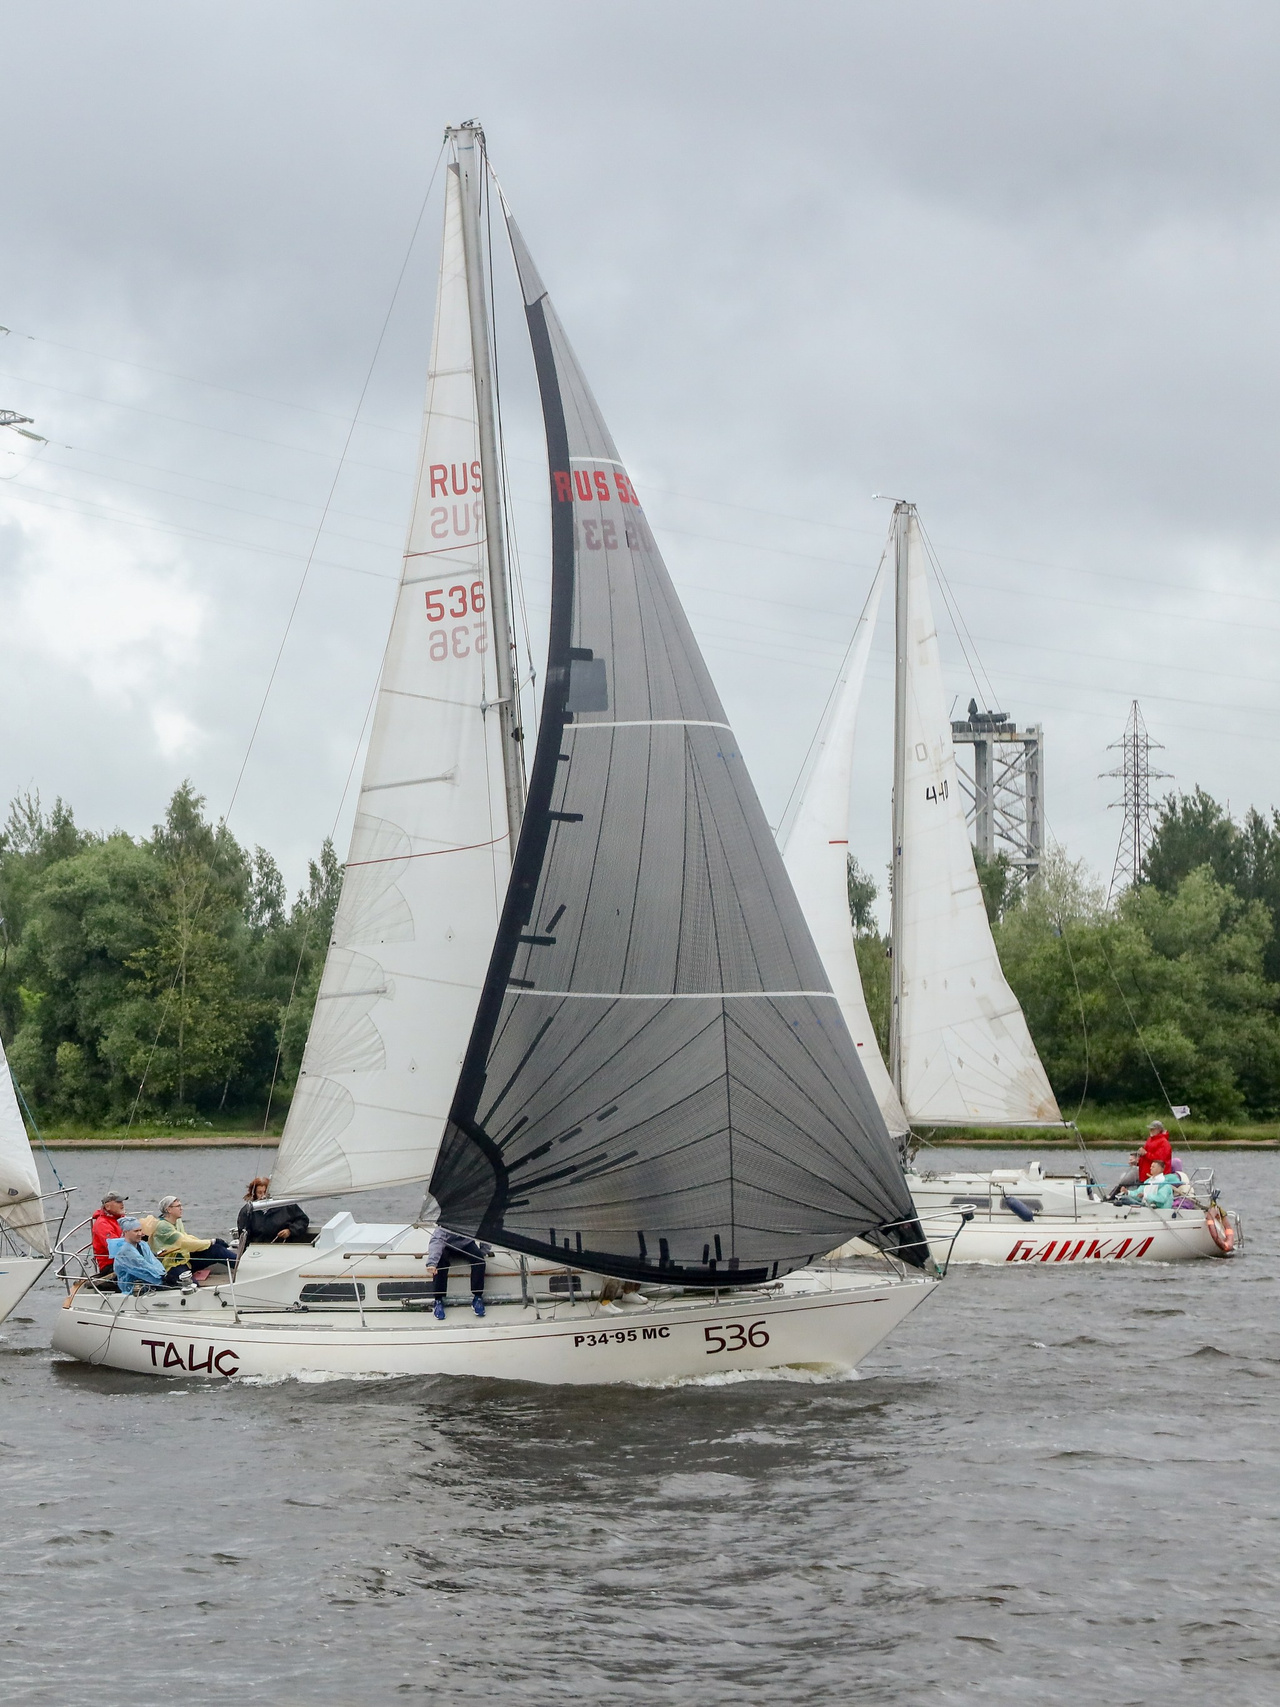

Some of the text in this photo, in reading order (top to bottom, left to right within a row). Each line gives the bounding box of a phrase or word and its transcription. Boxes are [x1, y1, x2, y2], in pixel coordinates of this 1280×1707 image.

[429, 460, 482, 498] RUS
[554, 470, 609, 502] RUS
[425, 580, 486, 622] 536
[704, 1320, 770, 1354] 536
